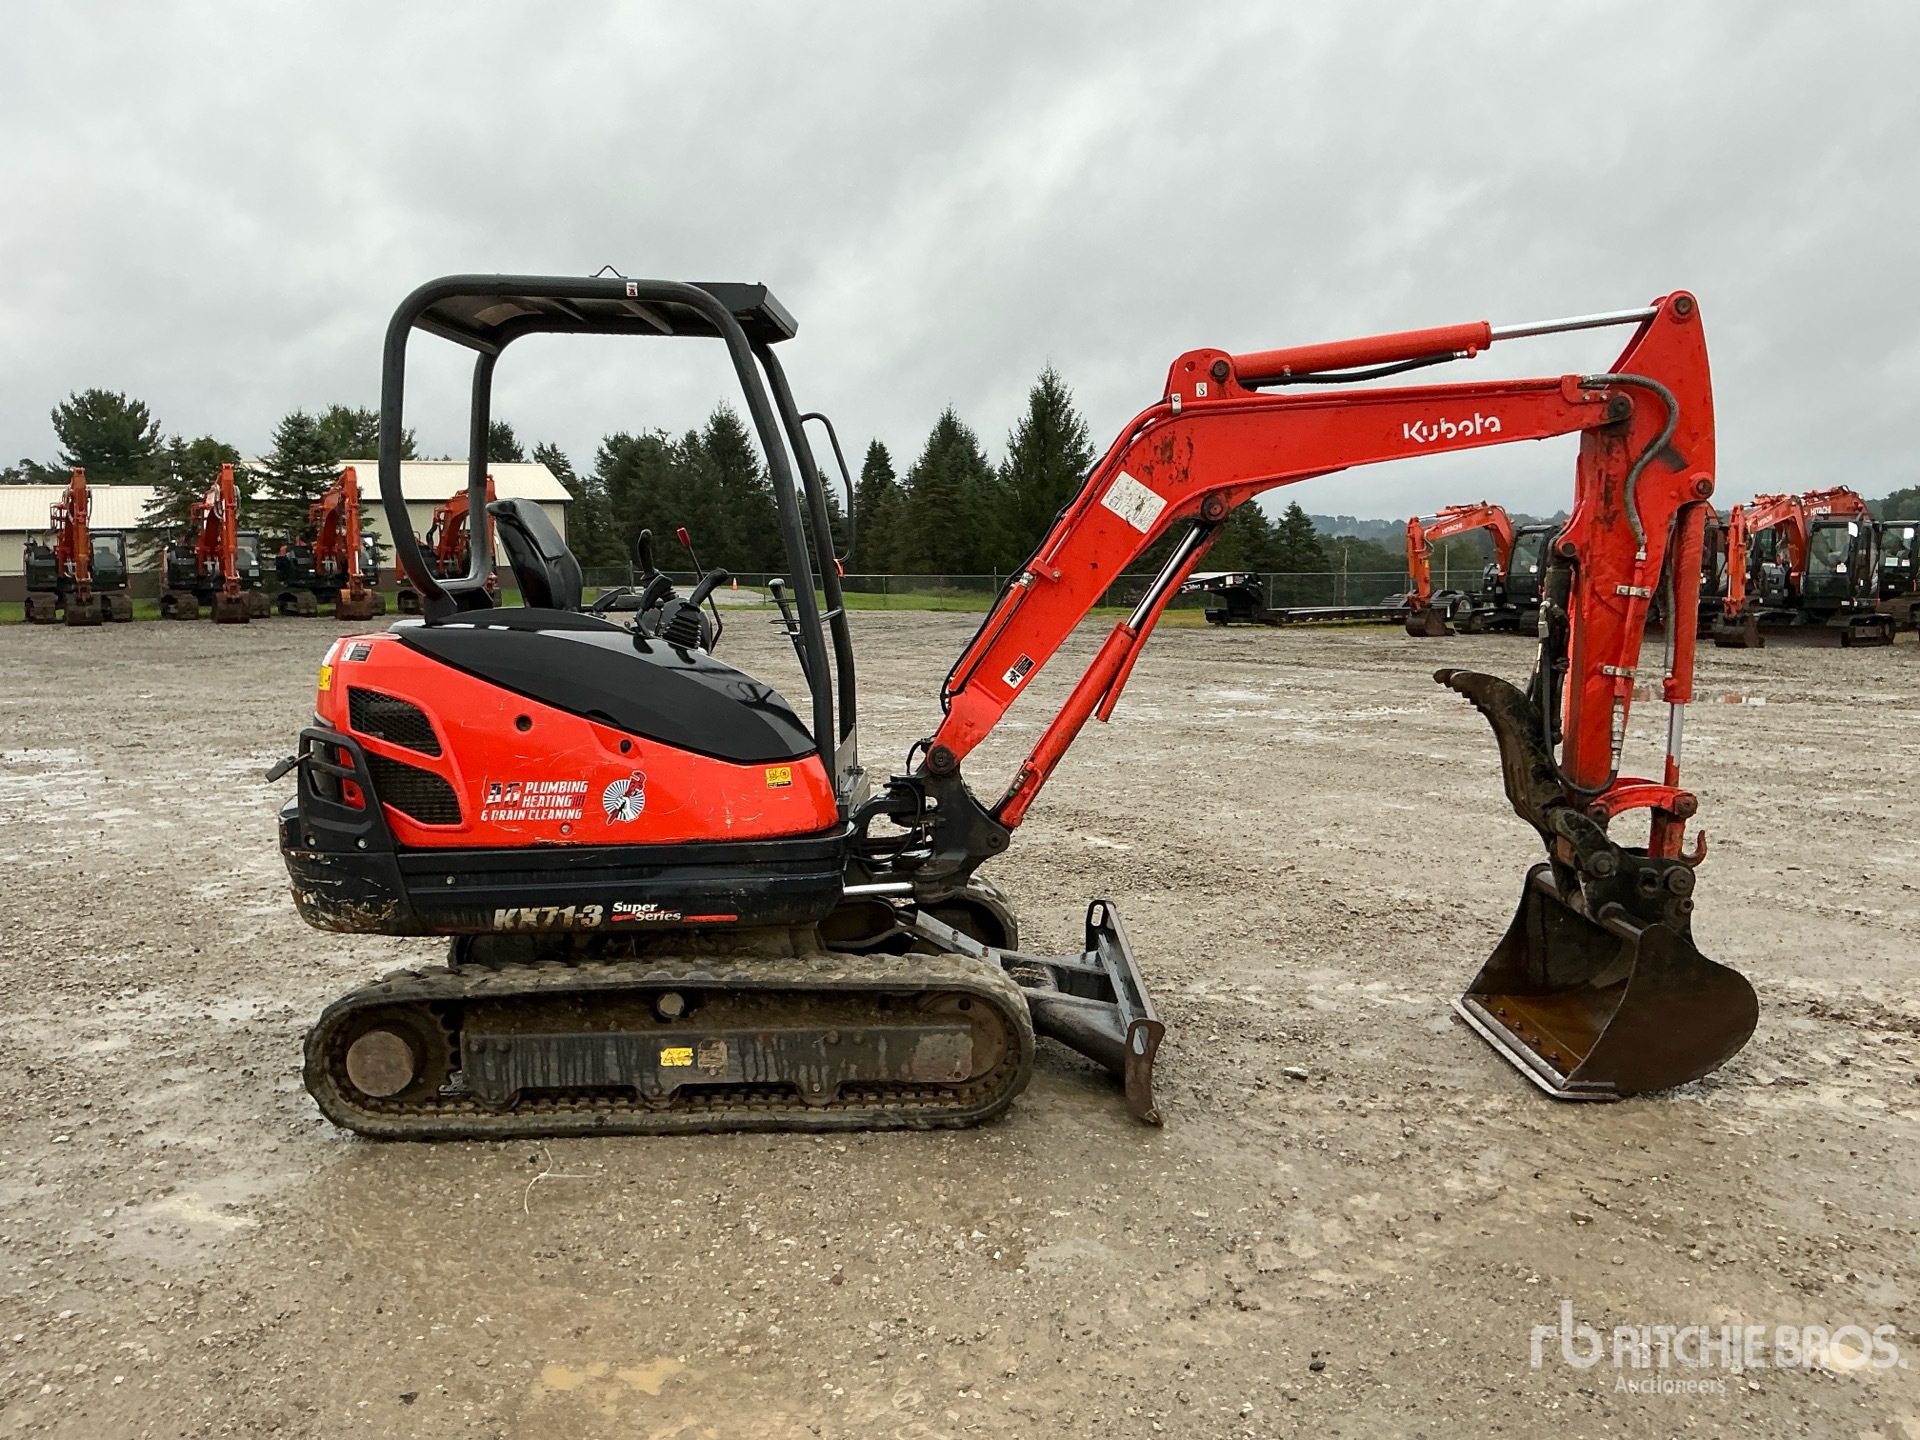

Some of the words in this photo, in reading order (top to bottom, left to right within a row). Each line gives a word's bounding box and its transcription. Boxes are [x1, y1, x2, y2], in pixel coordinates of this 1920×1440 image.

[1403, 412, 1501, 443] Kubota
[1810, 506, 1831, 516] HITACHI
[524, 781, 589, 794] PLUMBING
[522, 795, 572, 808] HEATING
[527, 808, 583, 820] CLEANING
[612, 901, 658, 914] Super
[493, 904, 604, 931] KX71-3
[635, 910, 682, 921] Series
